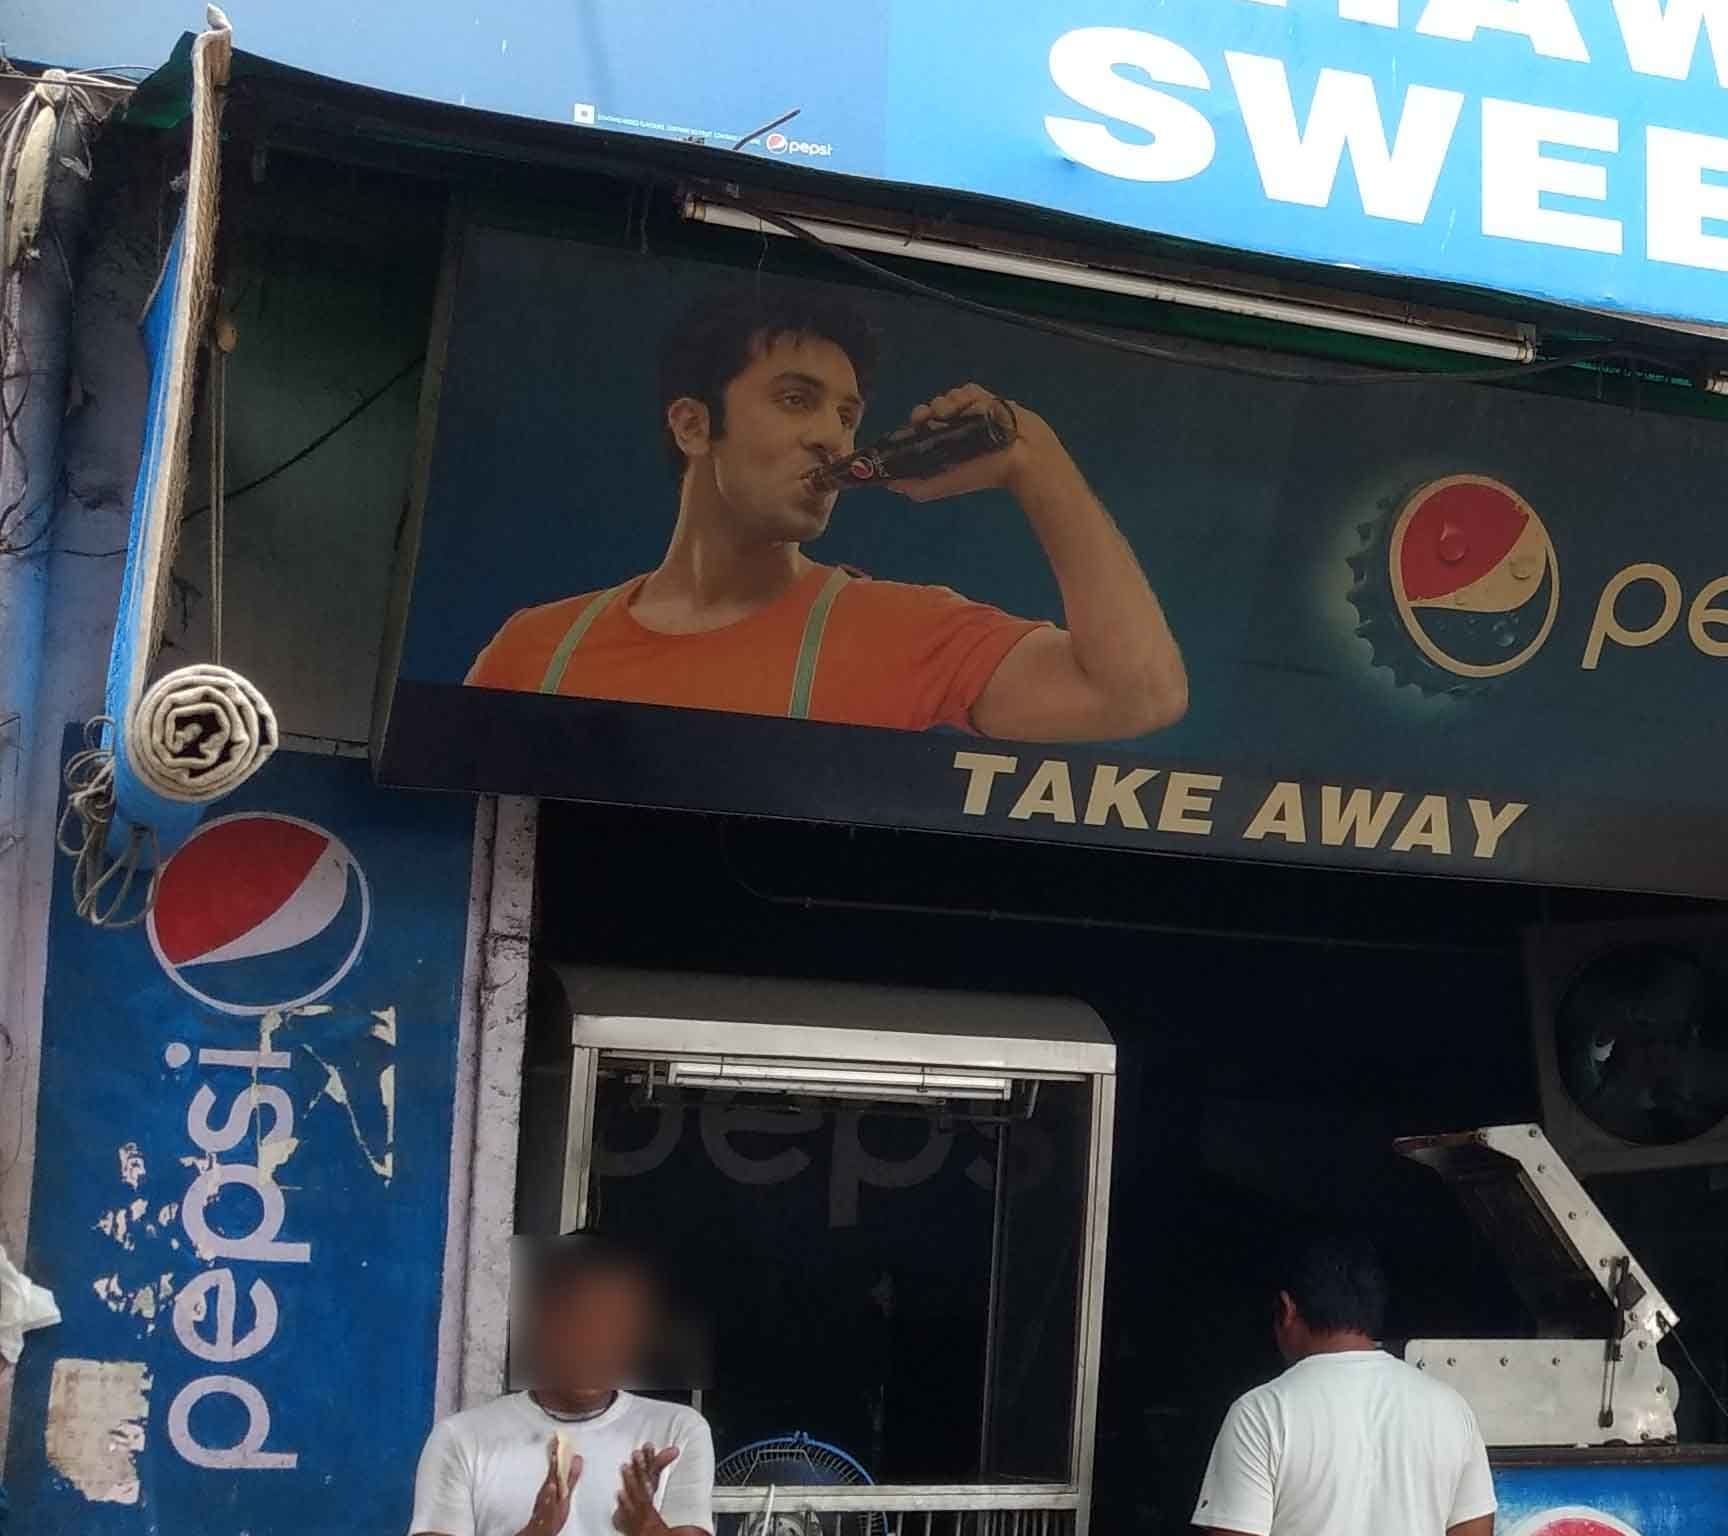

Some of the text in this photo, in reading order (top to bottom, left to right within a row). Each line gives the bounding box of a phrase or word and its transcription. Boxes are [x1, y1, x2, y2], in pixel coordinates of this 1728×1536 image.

[952, 751, 1530, 859] TAKE AWAY
[164, 1041, 311, 1469] pepsi
